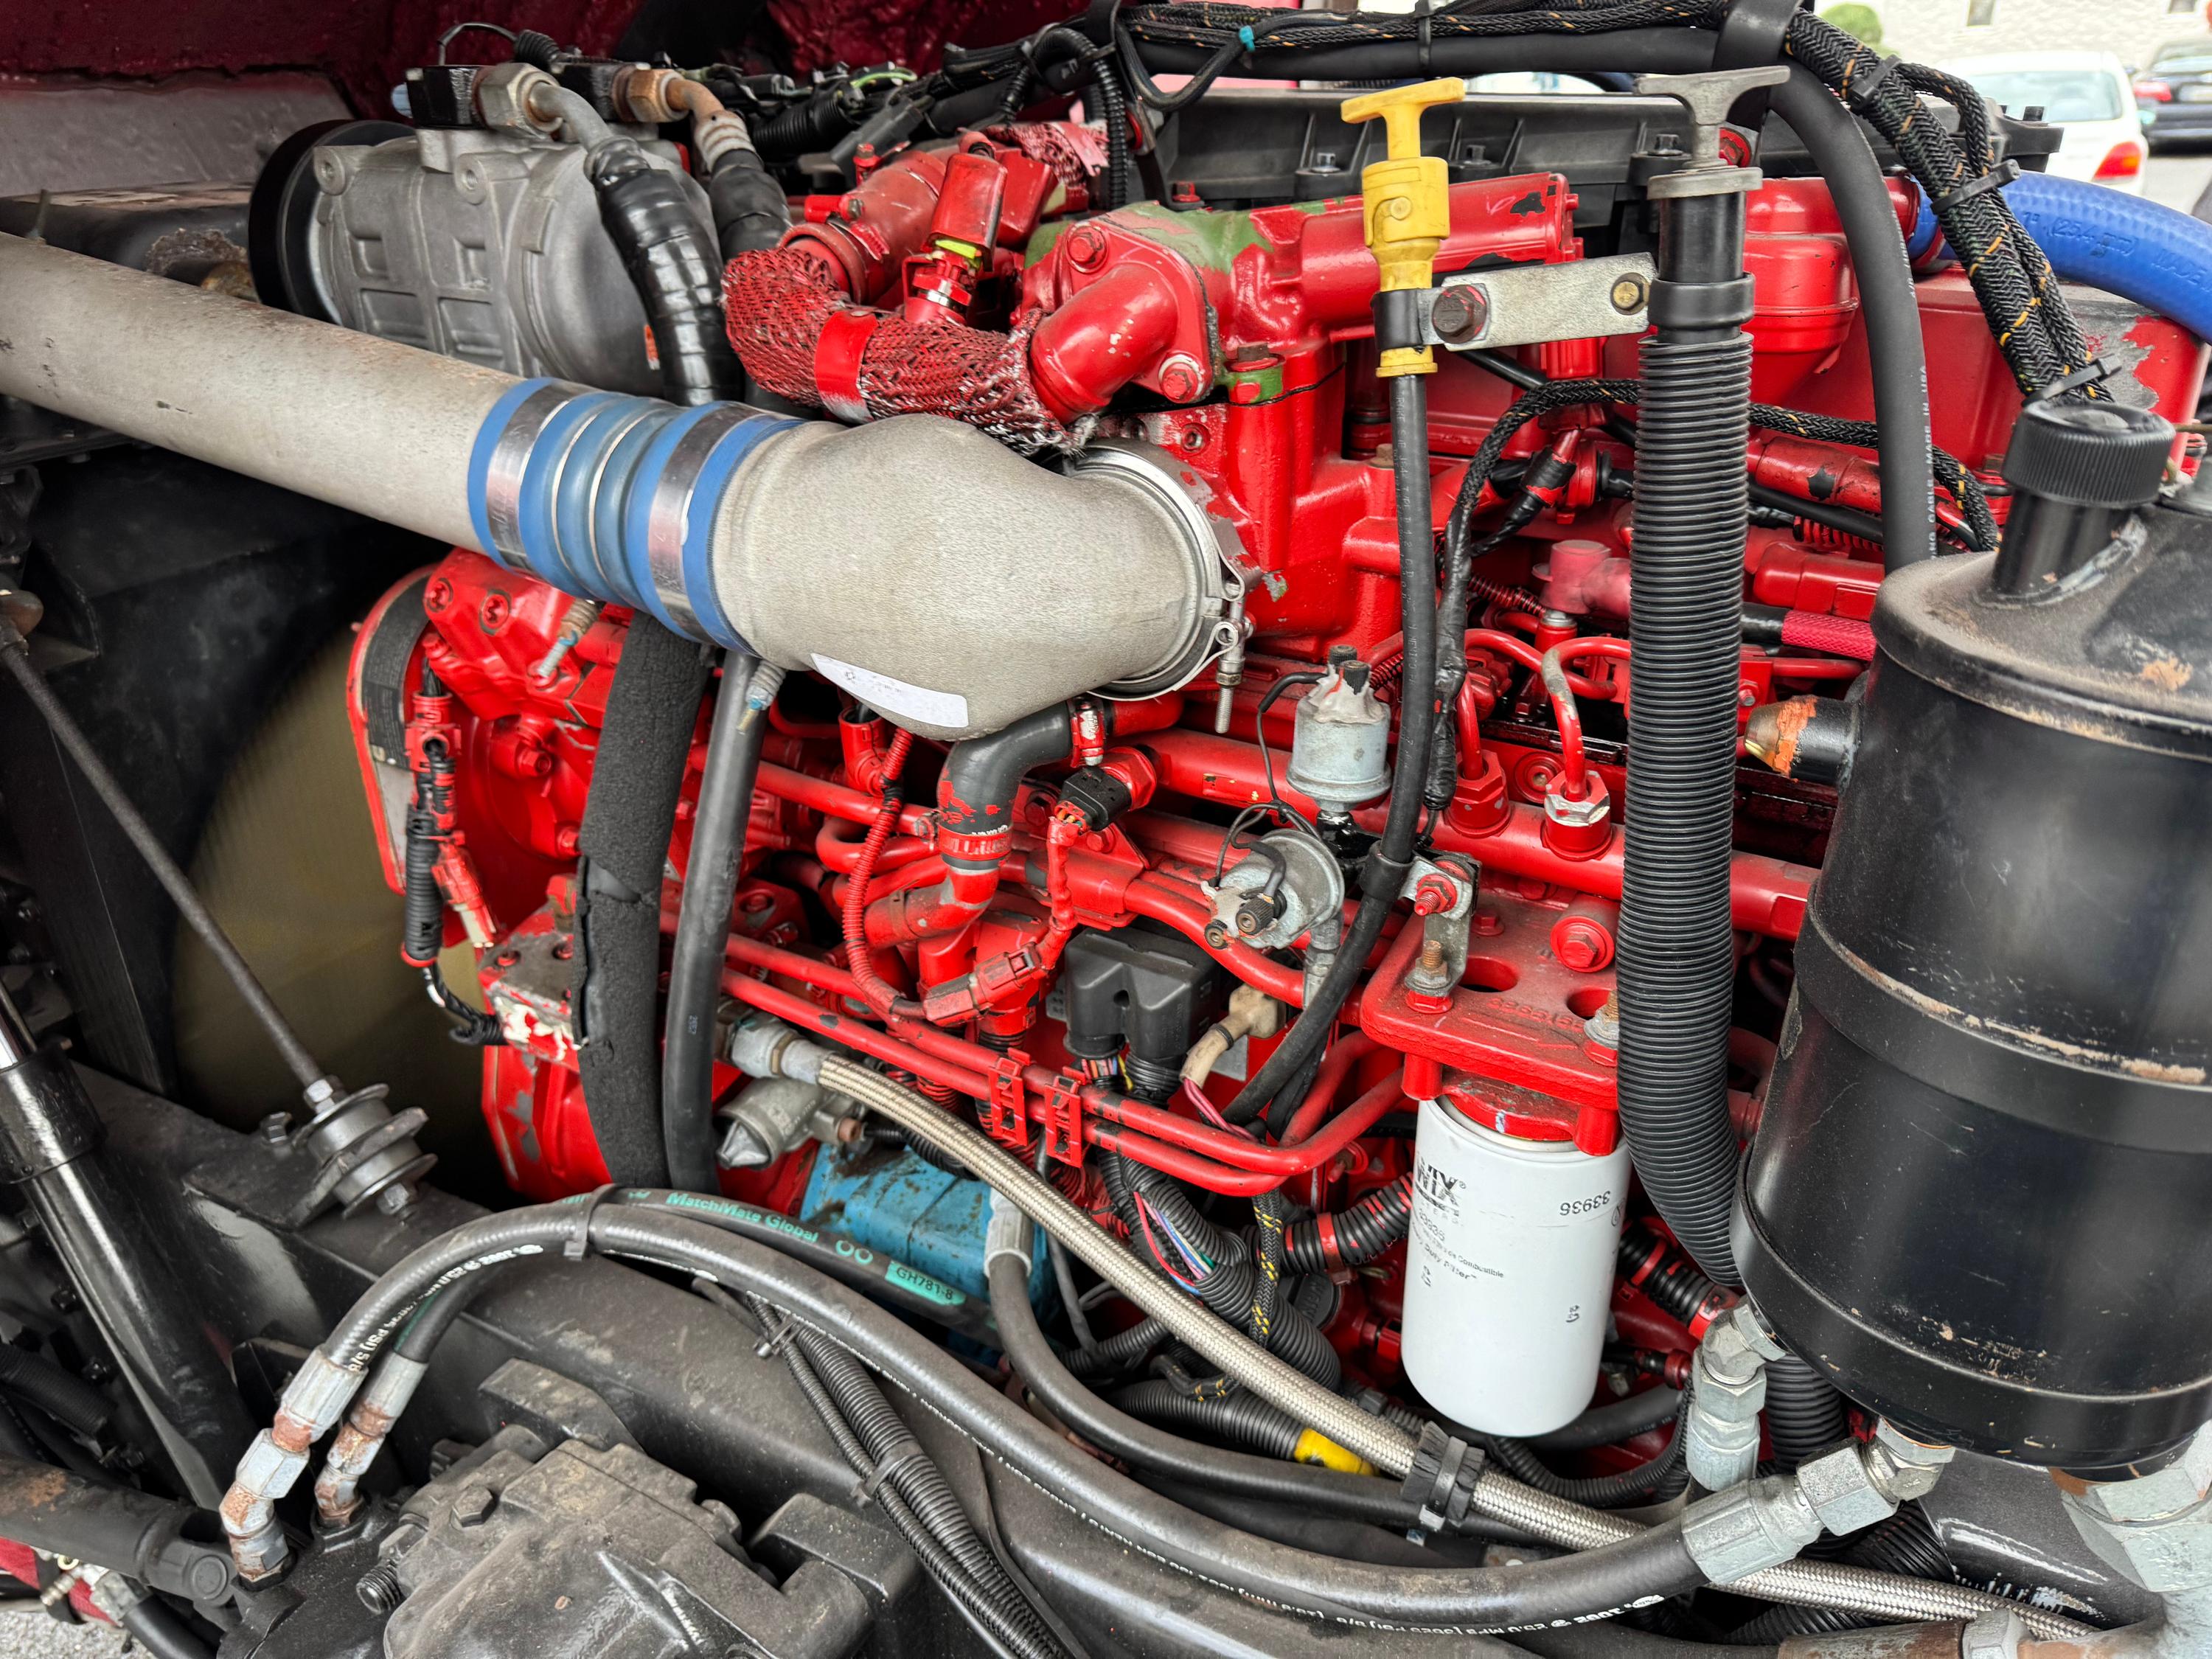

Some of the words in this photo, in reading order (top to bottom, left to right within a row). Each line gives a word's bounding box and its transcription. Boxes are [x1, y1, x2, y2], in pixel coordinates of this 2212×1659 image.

[1924, 425, 1933, 465] MADE
[666, 1191, 762, 1224] MatchMate
[764, 1213, 819, 1244] Global
[1559, 1190, 1611, 1217] 33936
[895, 1265, 954, 1301] GH781-8
